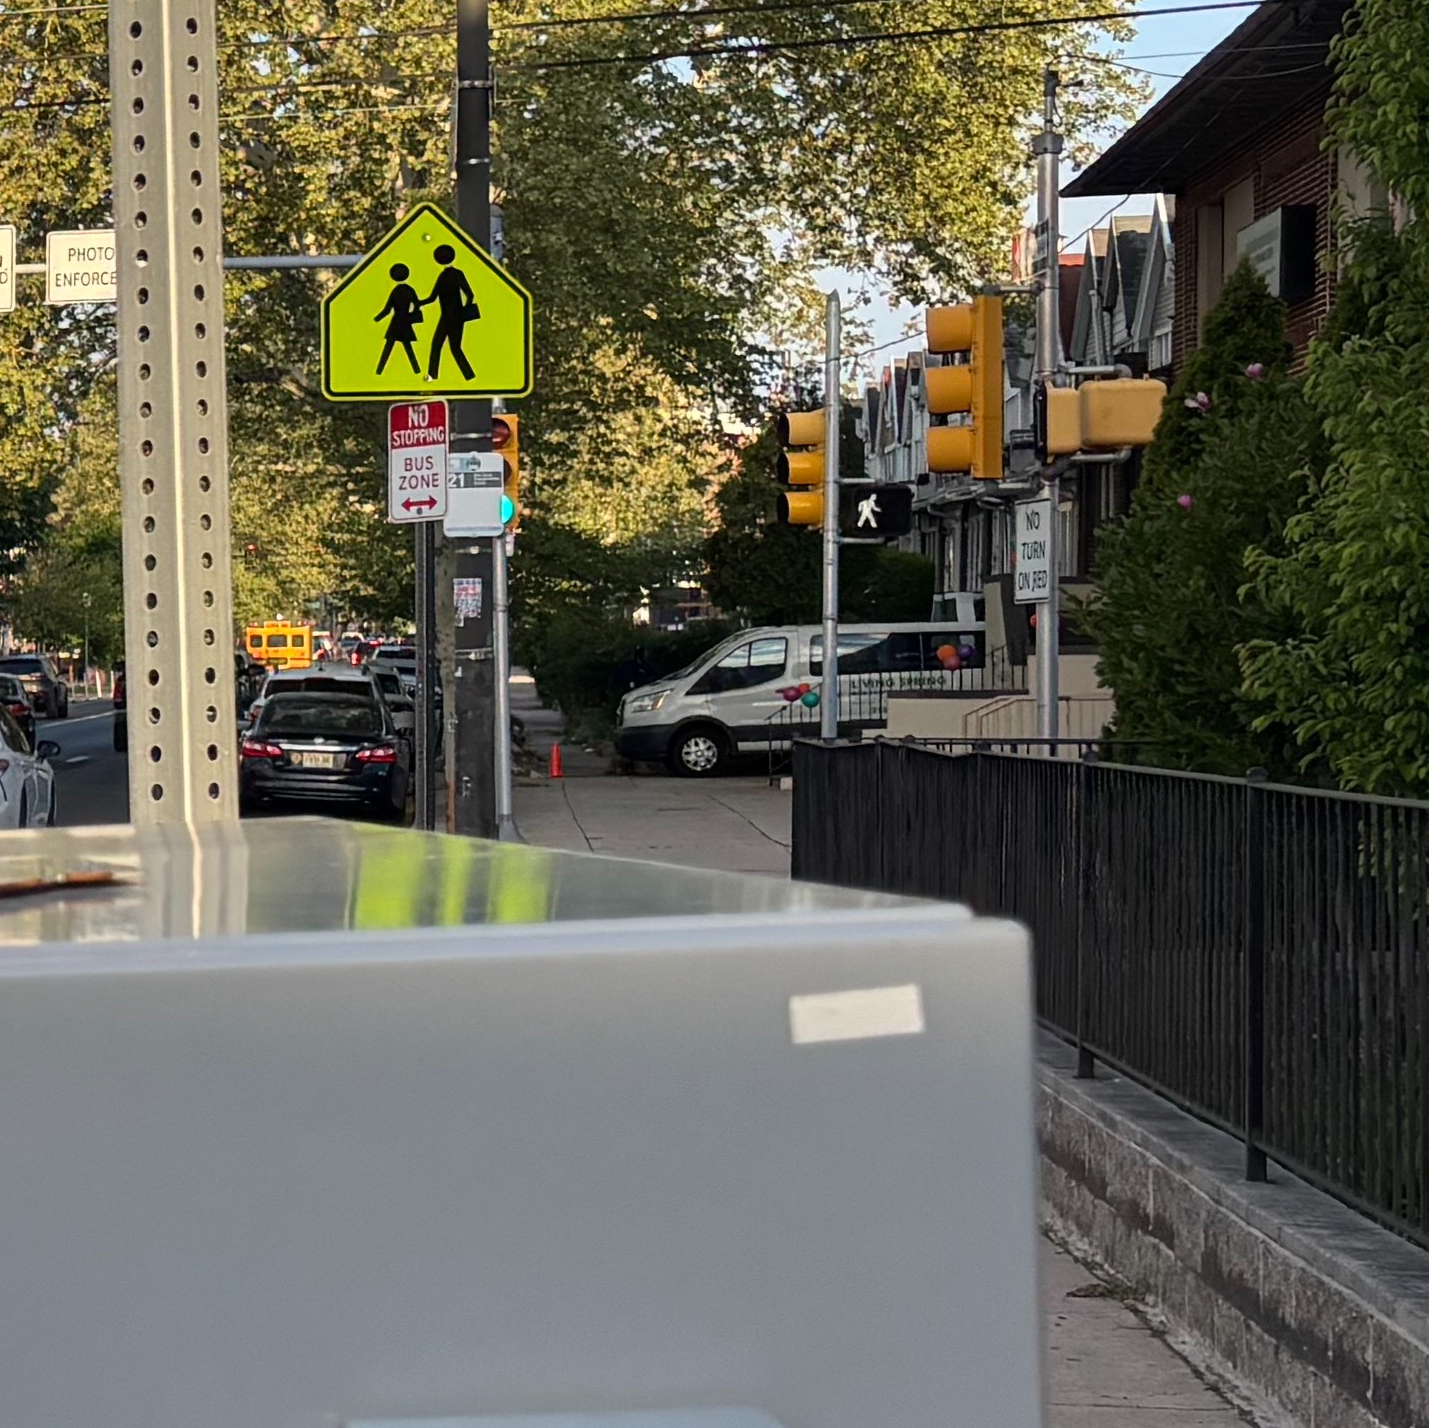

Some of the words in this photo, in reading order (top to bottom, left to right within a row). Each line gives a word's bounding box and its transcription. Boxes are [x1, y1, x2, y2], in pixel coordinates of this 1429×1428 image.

[68, 246, 115, 262] PHOTO
[55, 271, 117, 287] ENFORCE
[408, 404, 430, 428] NO
[392, 426, 445, 447] STOPPING
[404, 455, 434, 472] BUS
[398, 473, 440, 491] ZONE
[1025, 510, 1041, 531] NO
[1021, 540, 1046, 560] TURN
[1018, 571, 1031, 591] ON
[1031, 570, 1047, 592] RED
